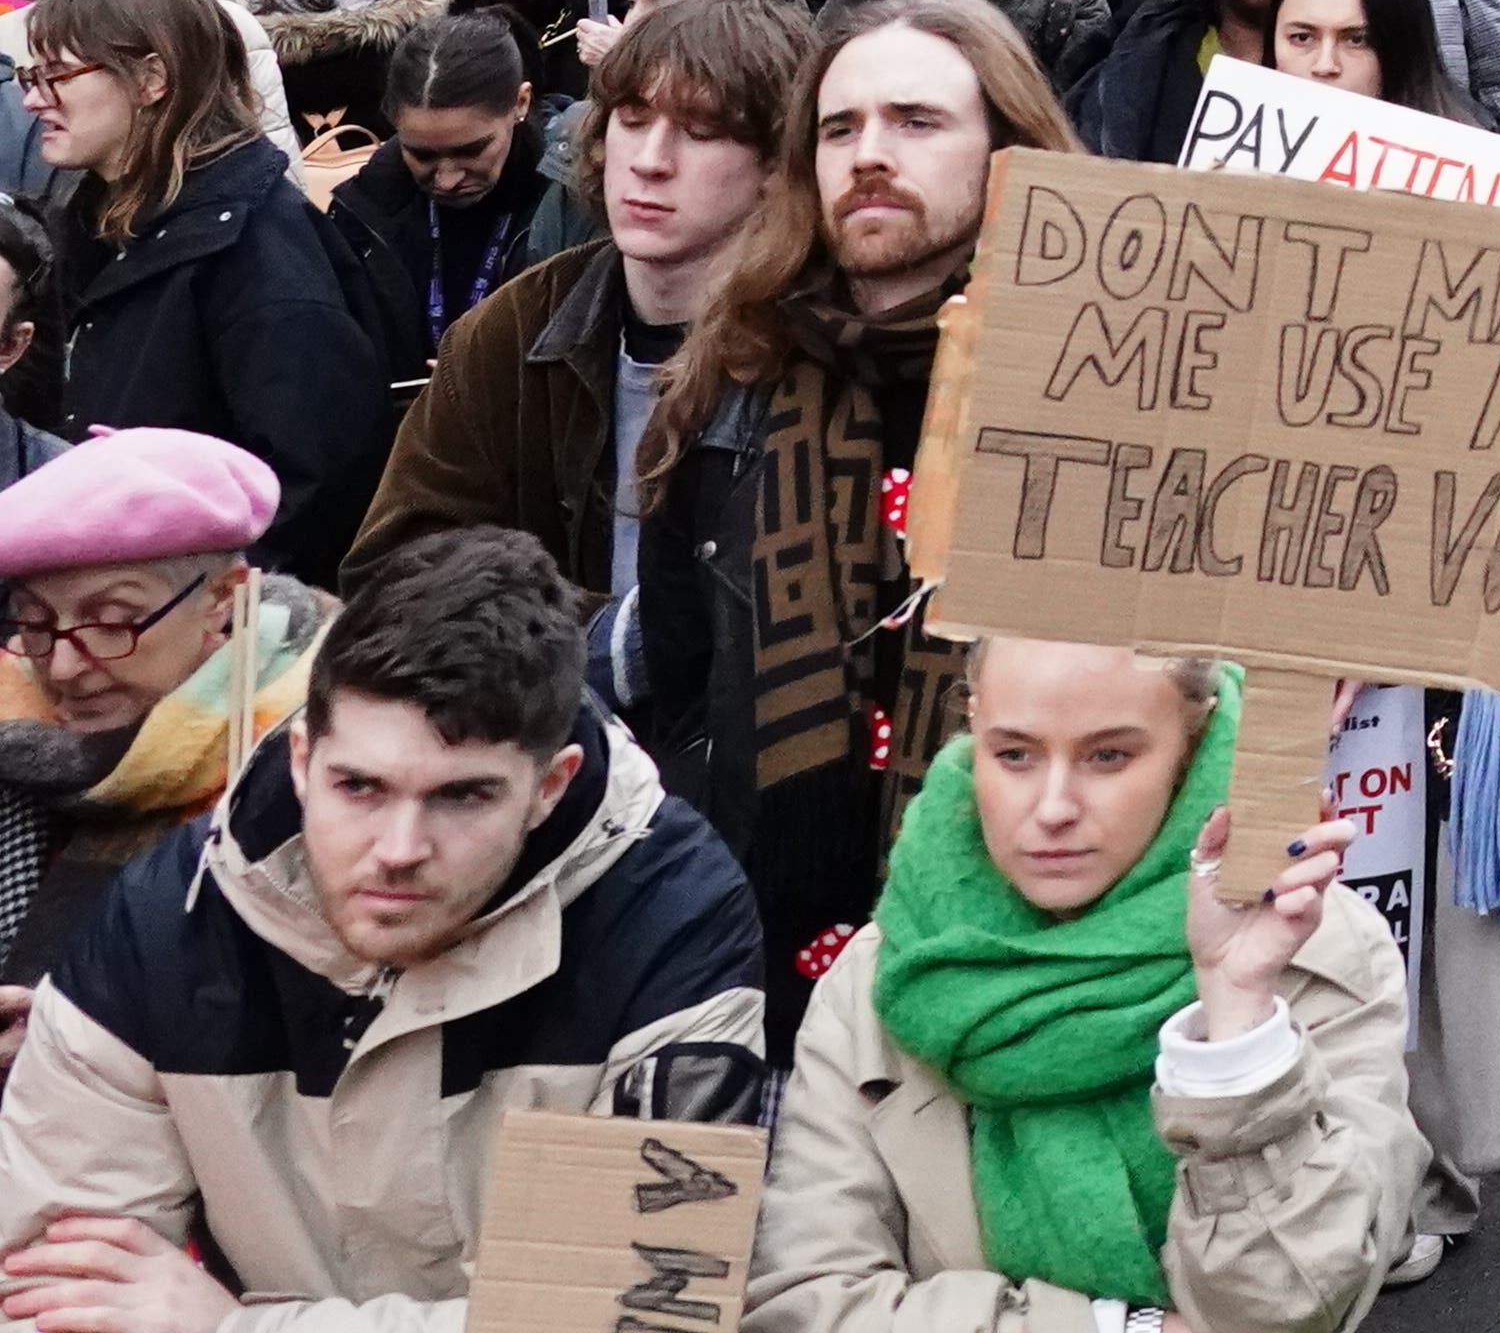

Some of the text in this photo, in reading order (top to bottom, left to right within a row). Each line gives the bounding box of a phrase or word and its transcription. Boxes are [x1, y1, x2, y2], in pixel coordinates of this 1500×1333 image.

[1184, 89, 1318, 173] PAY
[1046, 302, 1226, 412] ME
[1278, 320, 1440, 435] USE
[976, 428, 1396, 595] TEACHER
